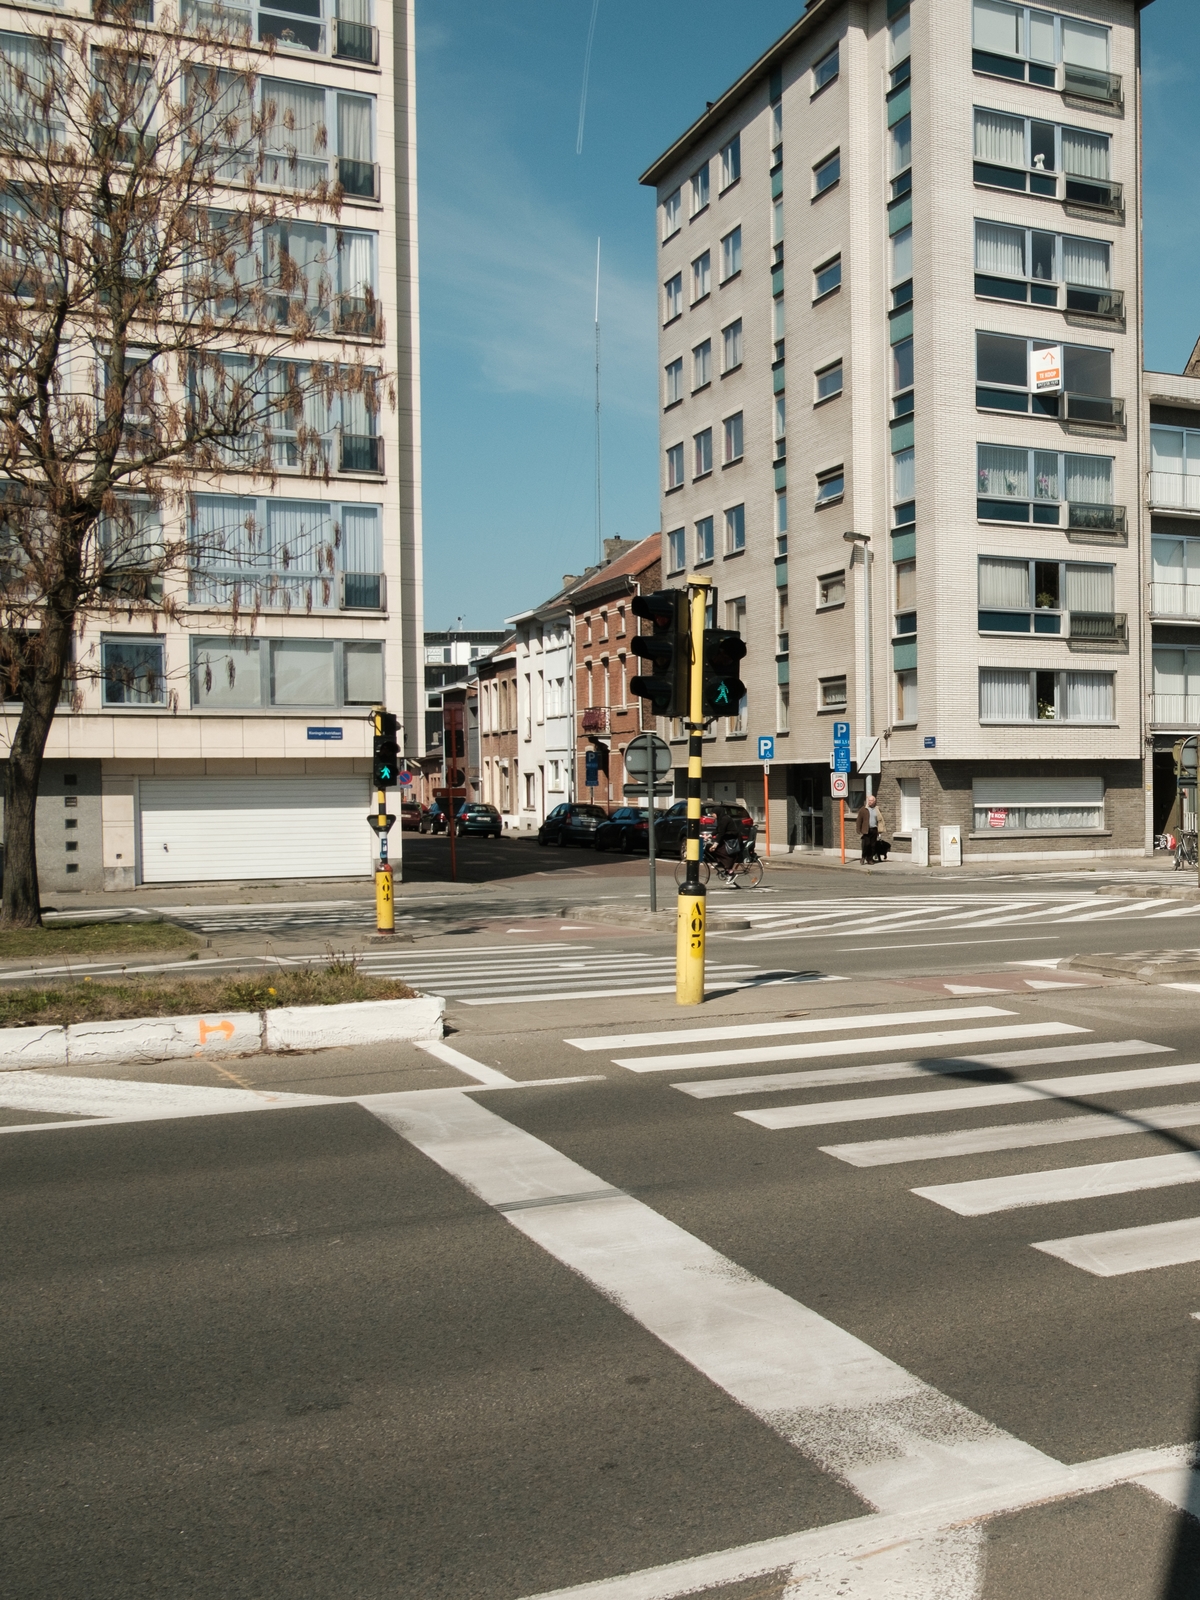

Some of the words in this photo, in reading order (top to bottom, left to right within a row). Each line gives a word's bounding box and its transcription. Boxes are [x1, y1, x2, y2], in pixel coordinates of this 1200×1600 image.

[837, 724, 846, 737] P
[760, 740, 772, 756] P
[589, 753, 596, 762] P
[691, 902, 702, 949] A05
